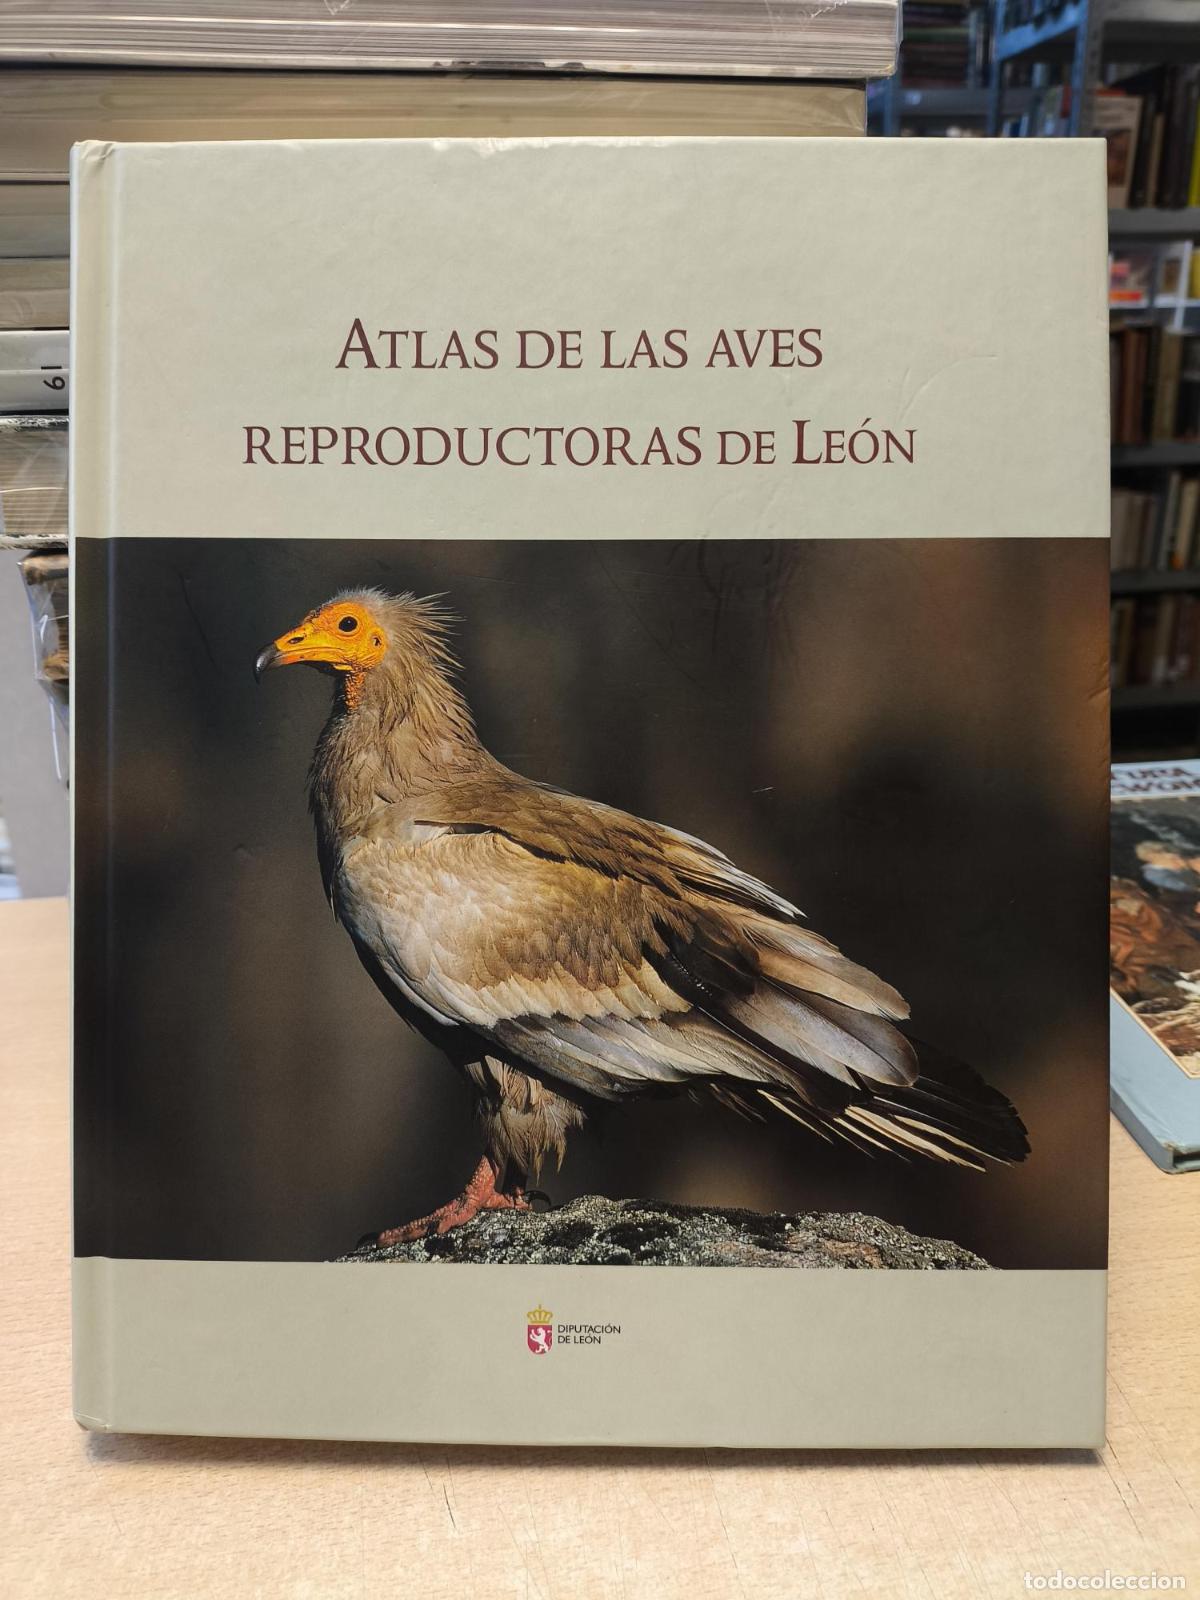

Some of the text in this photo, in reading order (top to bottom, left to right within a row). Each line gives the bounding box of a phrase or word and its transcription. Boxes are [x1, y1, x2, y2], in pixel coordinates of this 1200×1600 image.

[335, 317, 823, 369] ATLAS DE LAS AVES
[242, 417, 918, 466] REPRODUCTORAS DE LEÓN
[557, 1322, 622, 1334] DIPUTACIÓN
[557, 1334, 602, 1345] DE LEÓN
